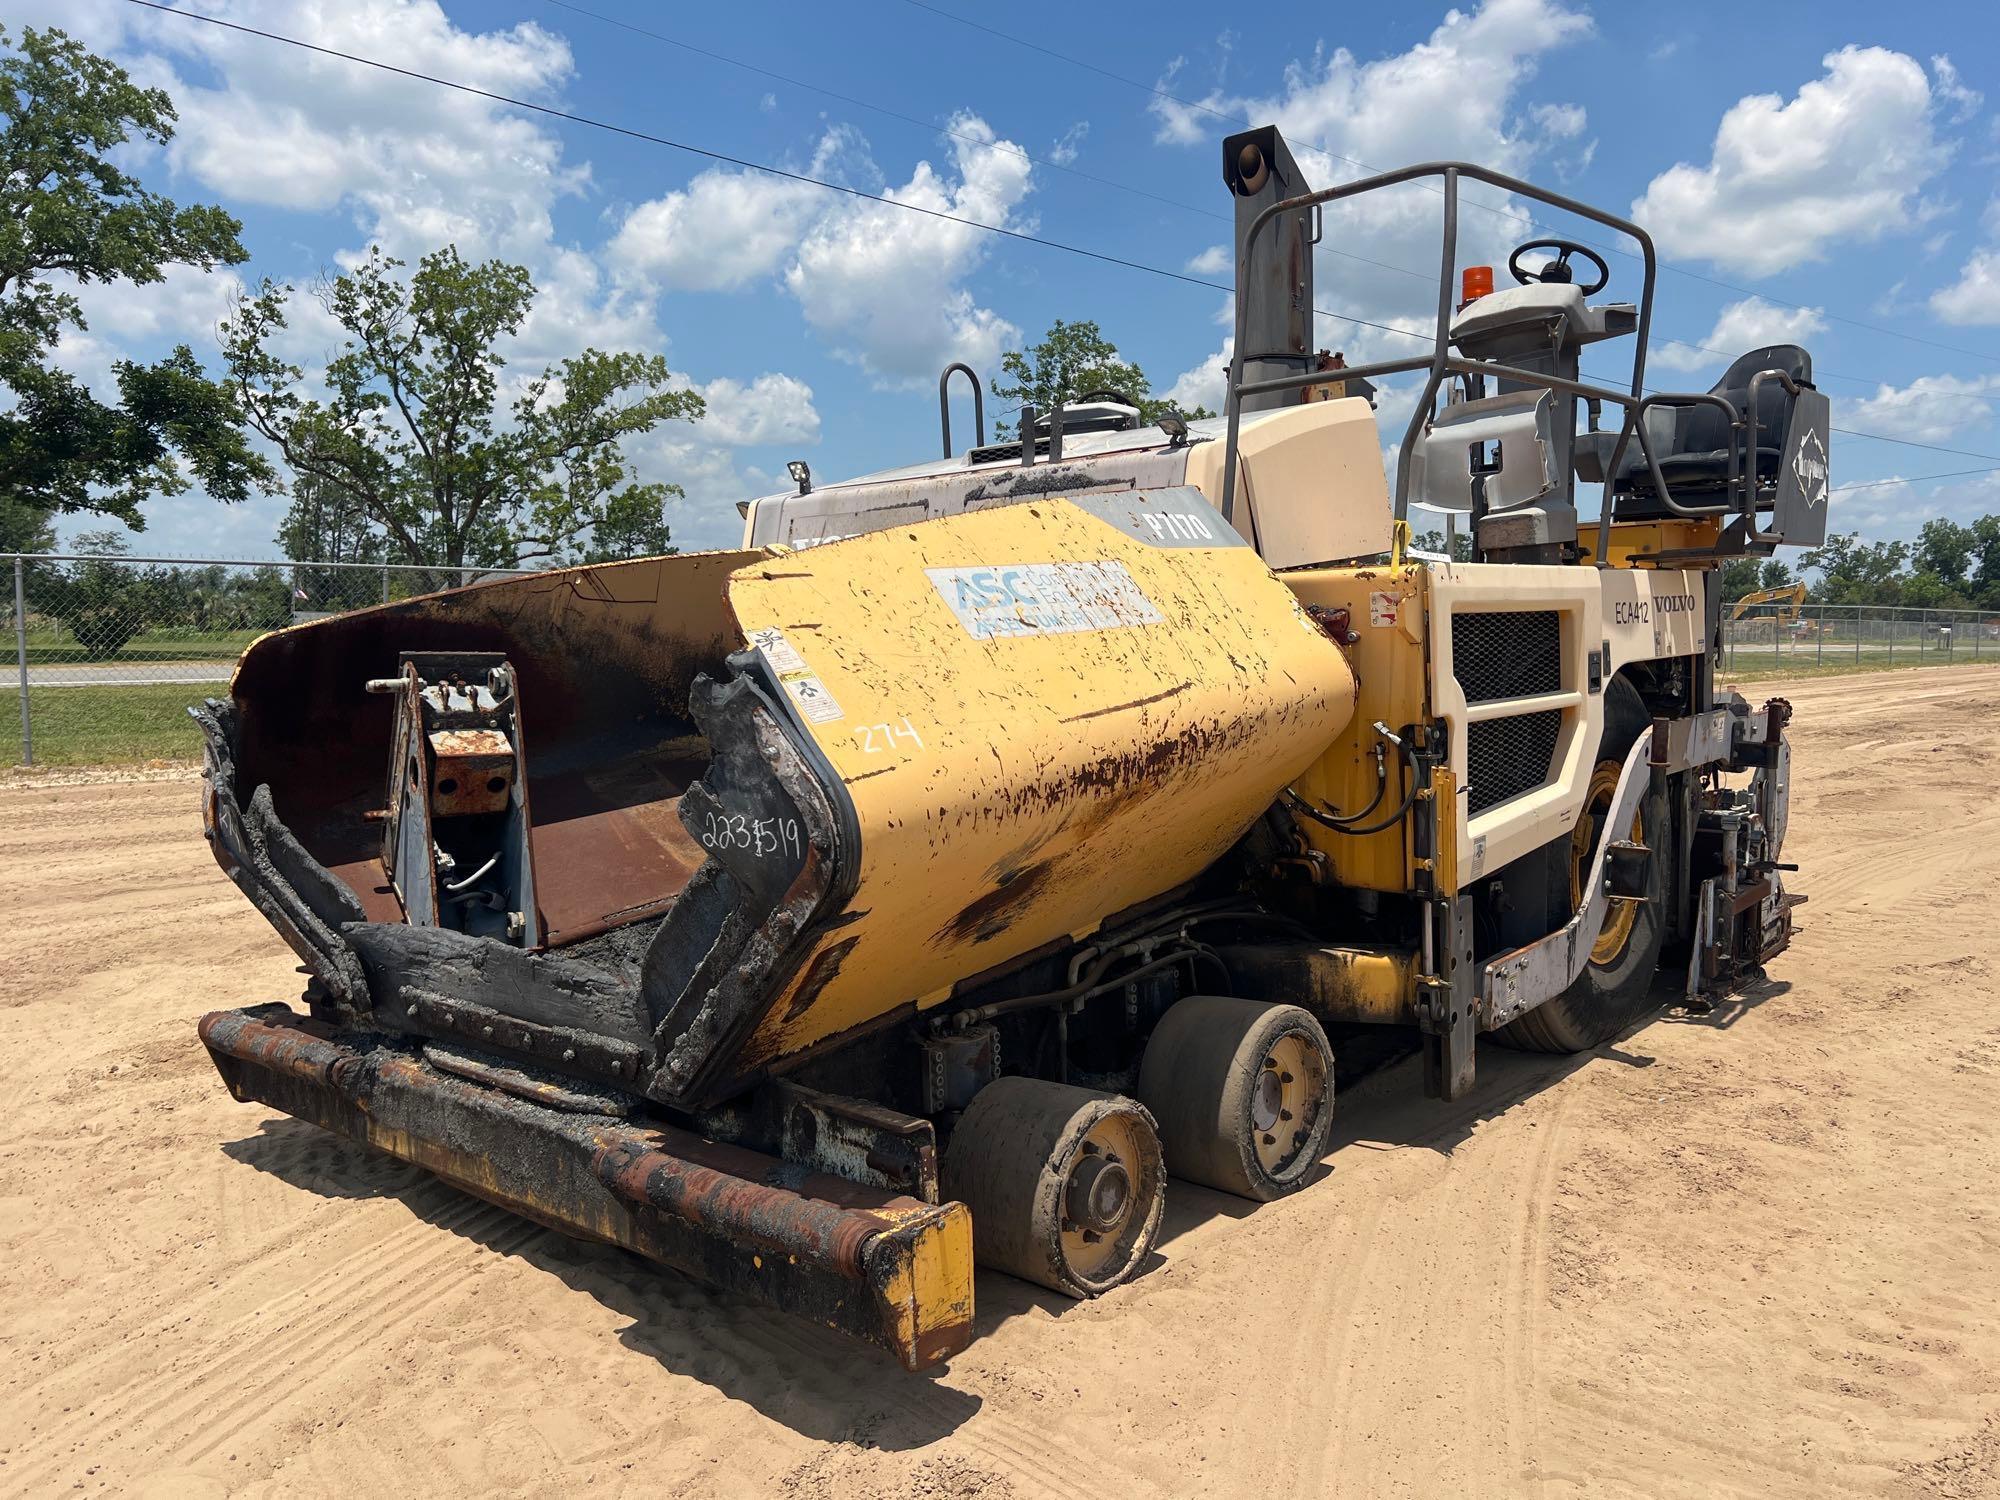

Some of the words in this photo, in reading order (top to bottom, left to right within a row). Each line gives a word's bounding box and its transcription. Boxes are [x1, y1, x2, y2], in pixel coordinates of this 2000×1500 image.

[1141, 513, 1213, 540] P7170
[954, 571, 1040, 610] ASC
[1615, 601, 1649, 625] ECA412
[1653, 594, 1696, 613] VOLVO
[854, 717, 926, 753] 274
